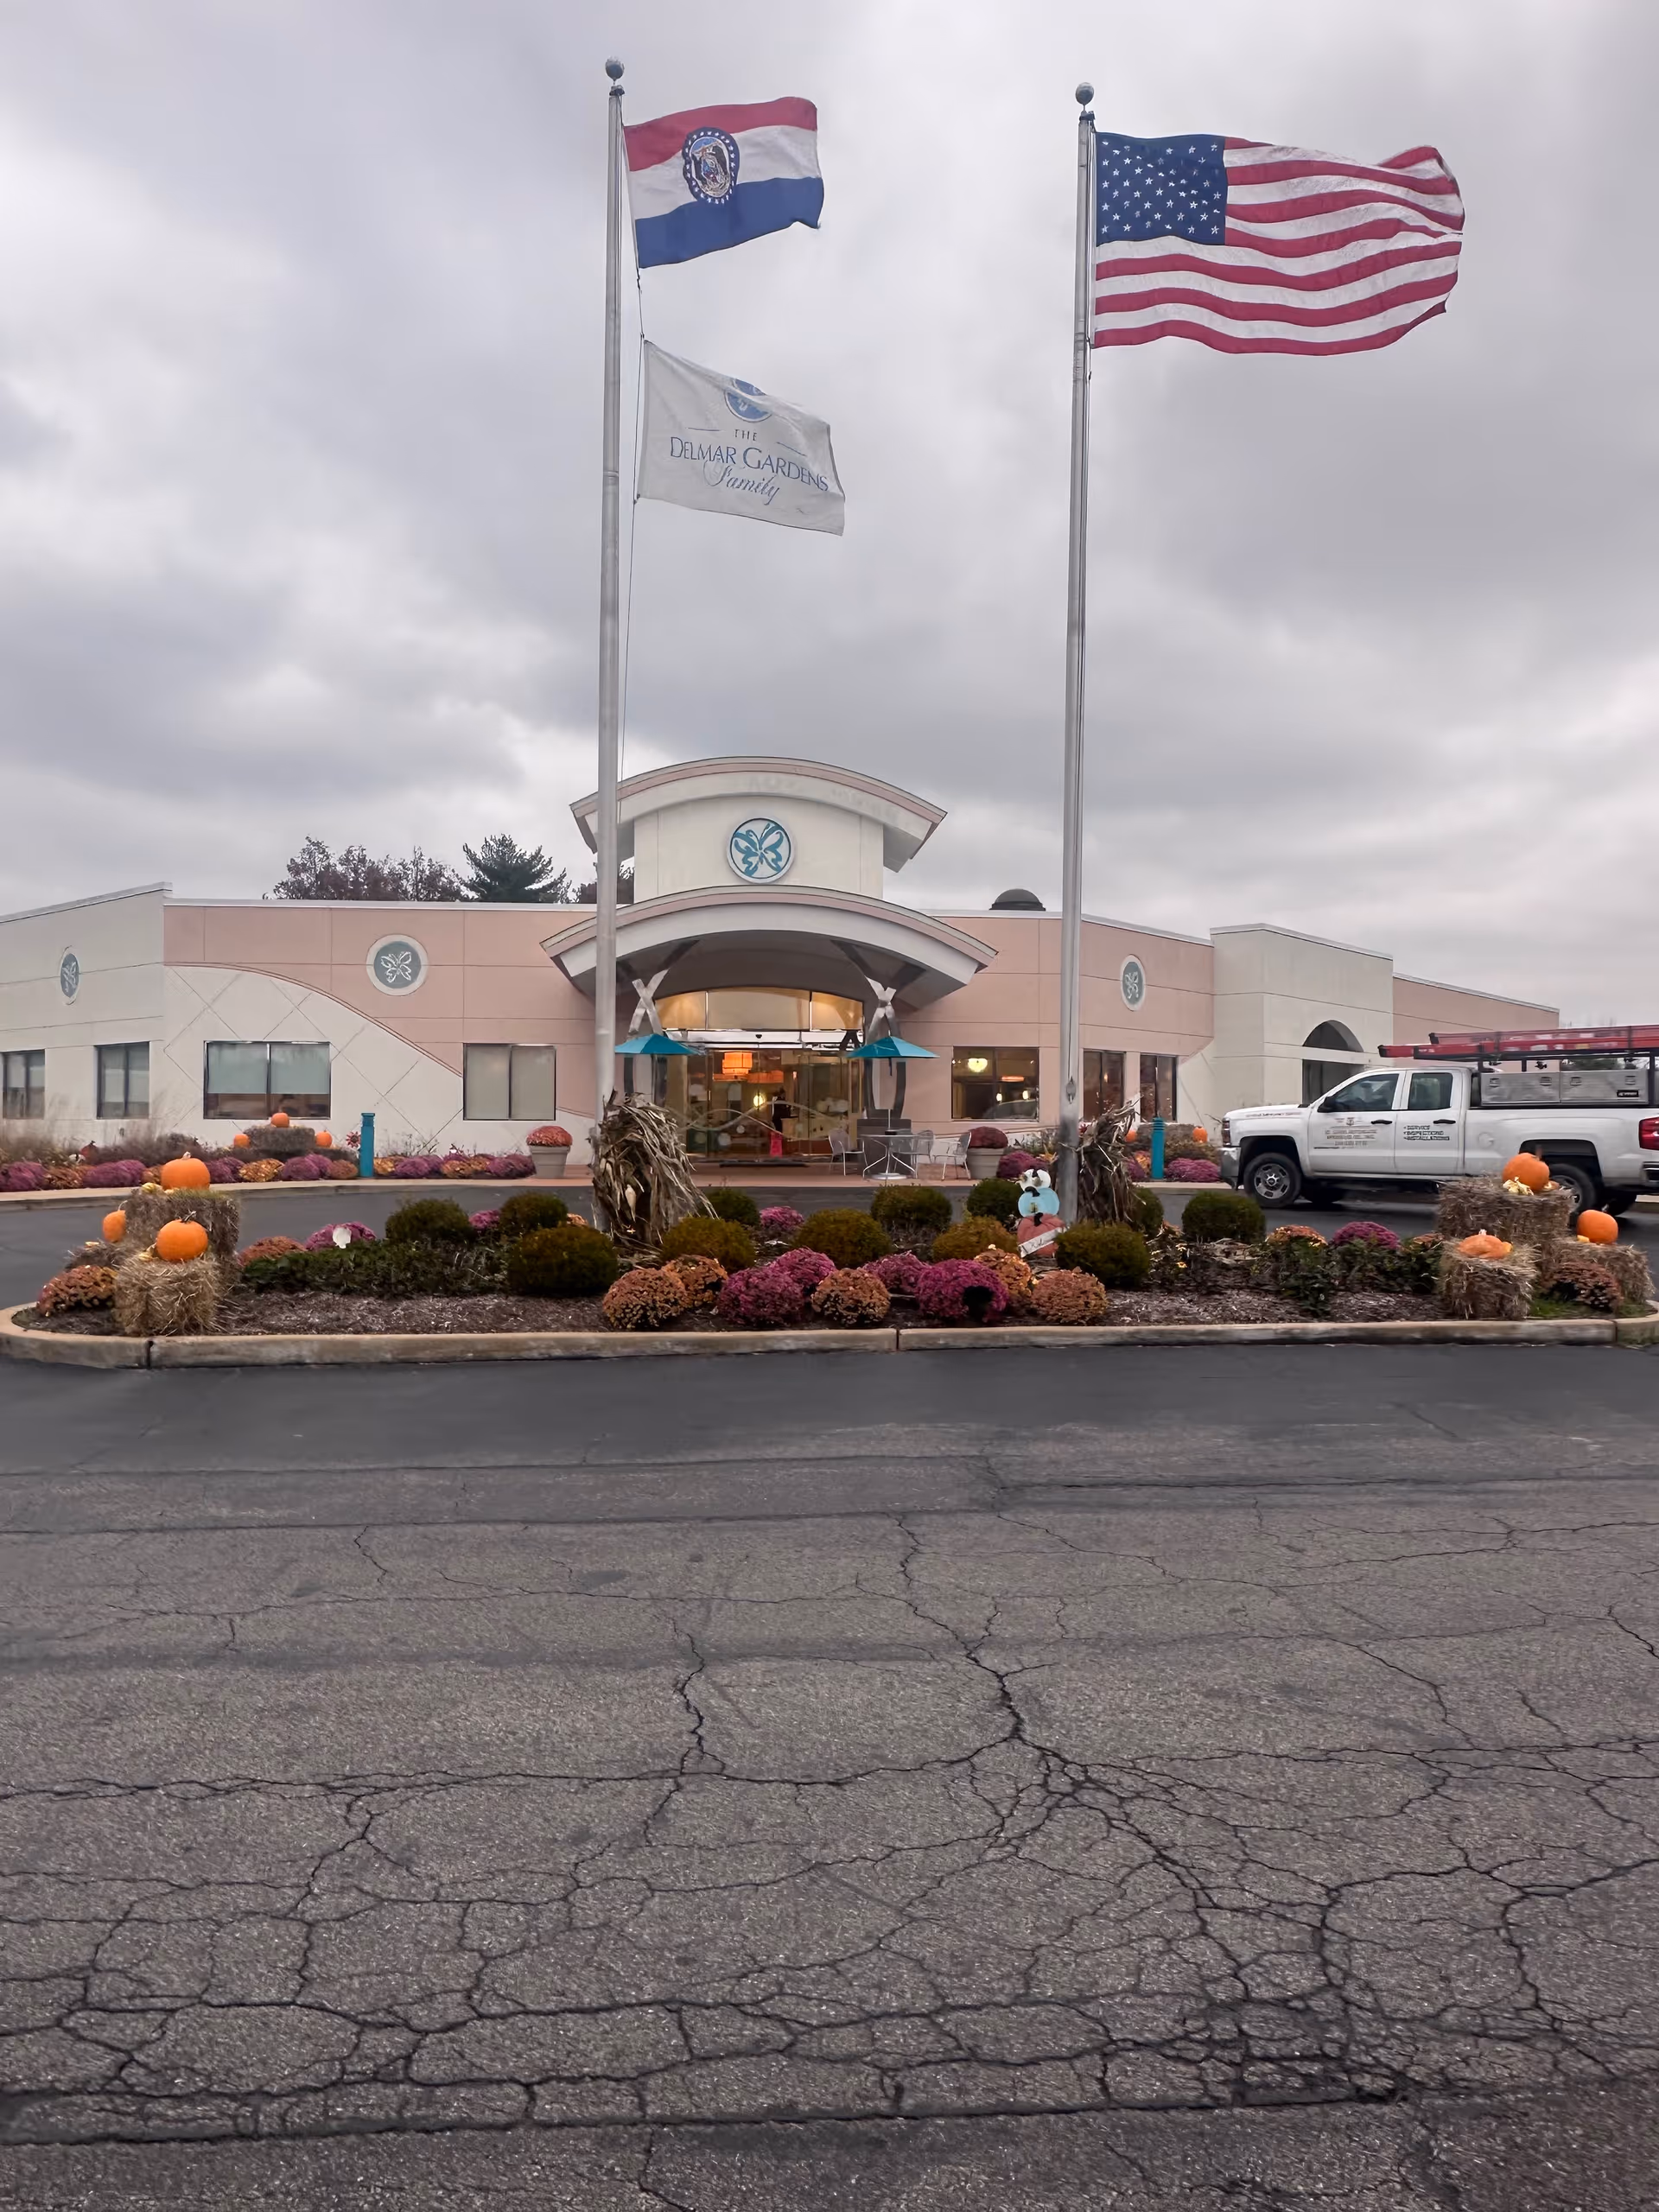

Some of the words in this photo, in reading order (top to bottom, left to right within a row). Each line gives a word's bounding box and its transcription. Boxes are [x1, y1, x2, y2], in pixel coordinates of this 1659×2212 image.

[734, 429, 757, 442] THE
[671, 436, 737, 465] DELMAR
[743, 447, 829, 492] GARDENS
[703, 460, 779, 505] Family
